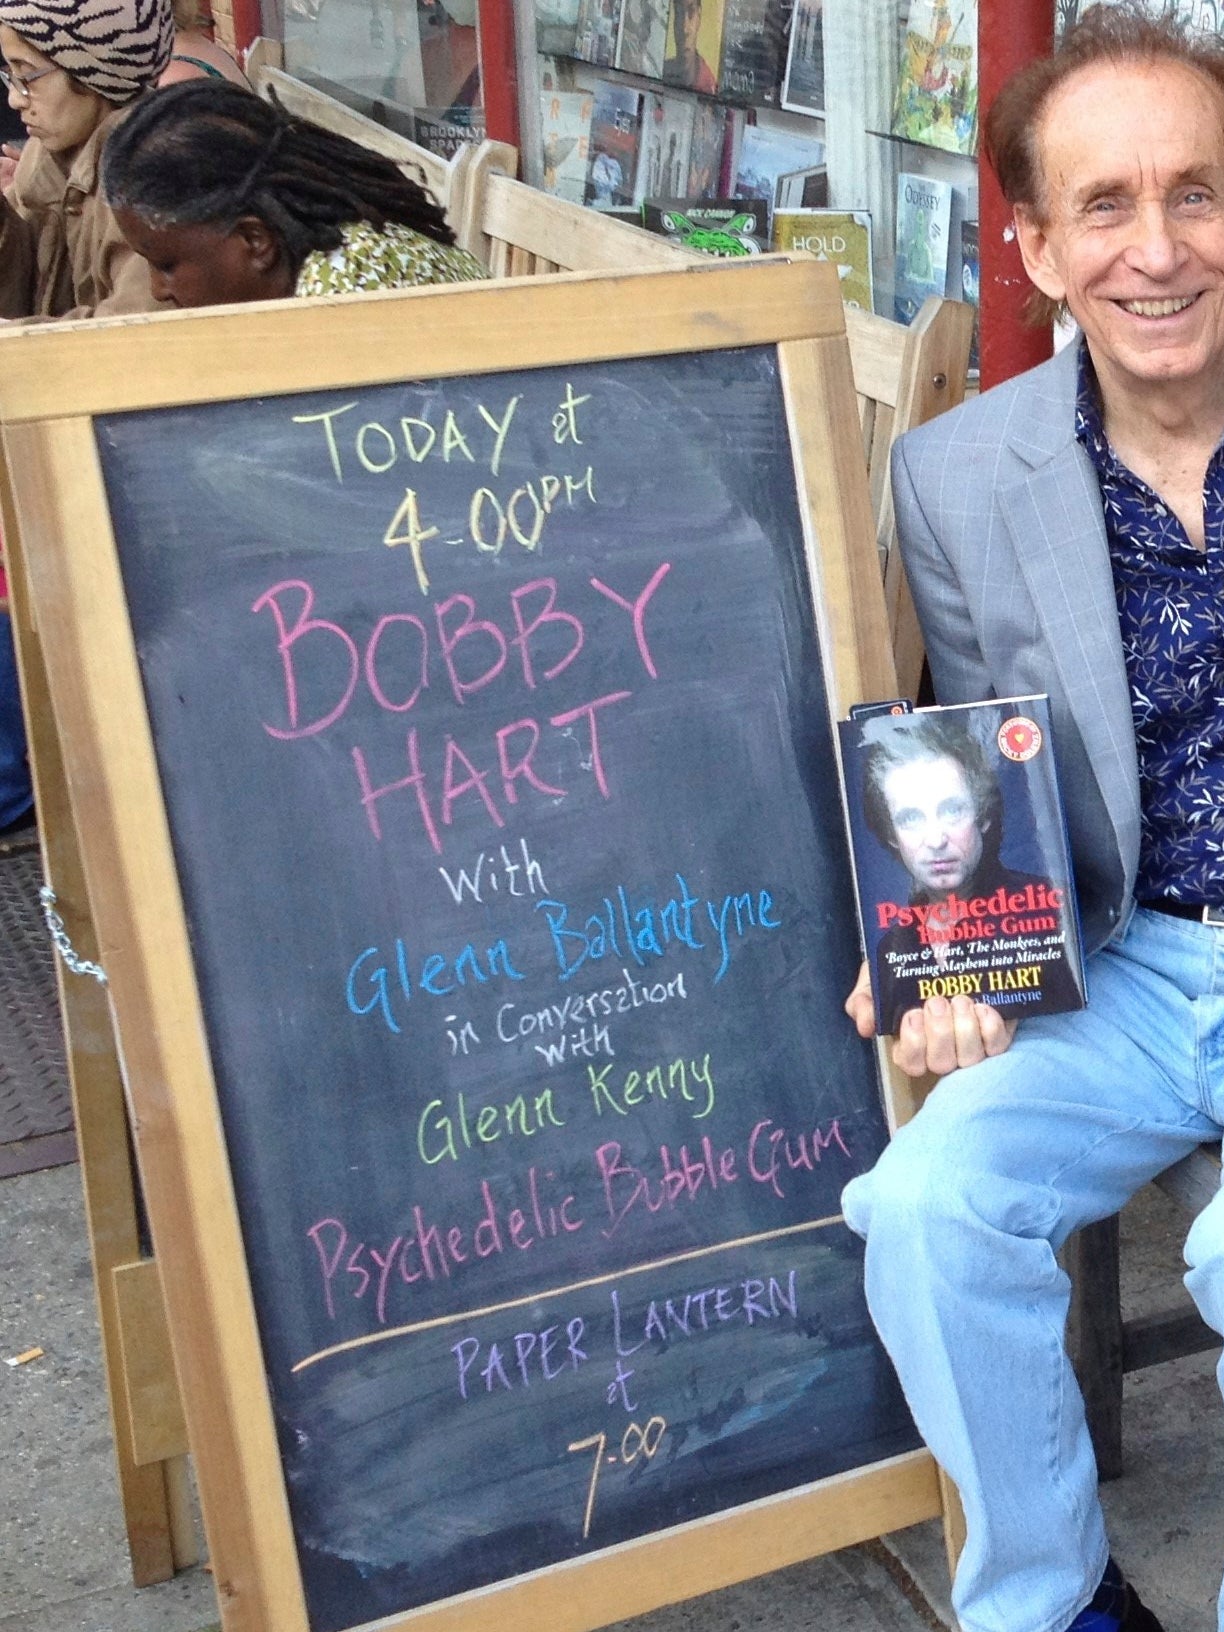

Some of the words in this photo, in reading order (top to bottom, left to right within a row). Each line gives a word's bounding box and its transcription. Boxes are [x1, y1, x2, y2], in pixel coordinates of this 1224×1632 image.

[904, 184, 941, 211] ODYSSEY
[792, 236, 846, 253] HOLD
[293, 393, 525, 484] TODAY
[551, 383, 593, 445] at
[252, 562, 671, 740] BOBBY
[352, 690, 633, 854] HART
[876, 884, 1064, 929] Psychedelic
[885, 951, 918, 966] Boyce
[921, 948, 932, 960] &
[967, 941, 990, 954] The
[1043, 930, 1066, 944] and
[917, 921, 996, 945] Bubble
[1001, 914, 1057, 936] Gum
[346, 938, 525, 1034] Glenn
[534, 872, 783, 985] Ballantyne
[893, 963, 940, 979] Turning
[942, 959, 989, 975] Mayhem
[991, 954, 1014, 966] into
[1015, 950, 1063, 964] Miracles
[918, 971, 983, 1000] BOBBY
[988, 966, 1042, 991] HART
[982, 990, 1043, 1006] Ballantyne
[444, 1016, 481, 1055] in
[416, 1088, 566, 1166] Glenn
[587, 1053, 716, 1120] Kenny
[306, 1167, 585, 1323] Psychedelic
[450, 1315, 587, 1400] PAPER
[610, 1270, 798, 1358] LANTERN
